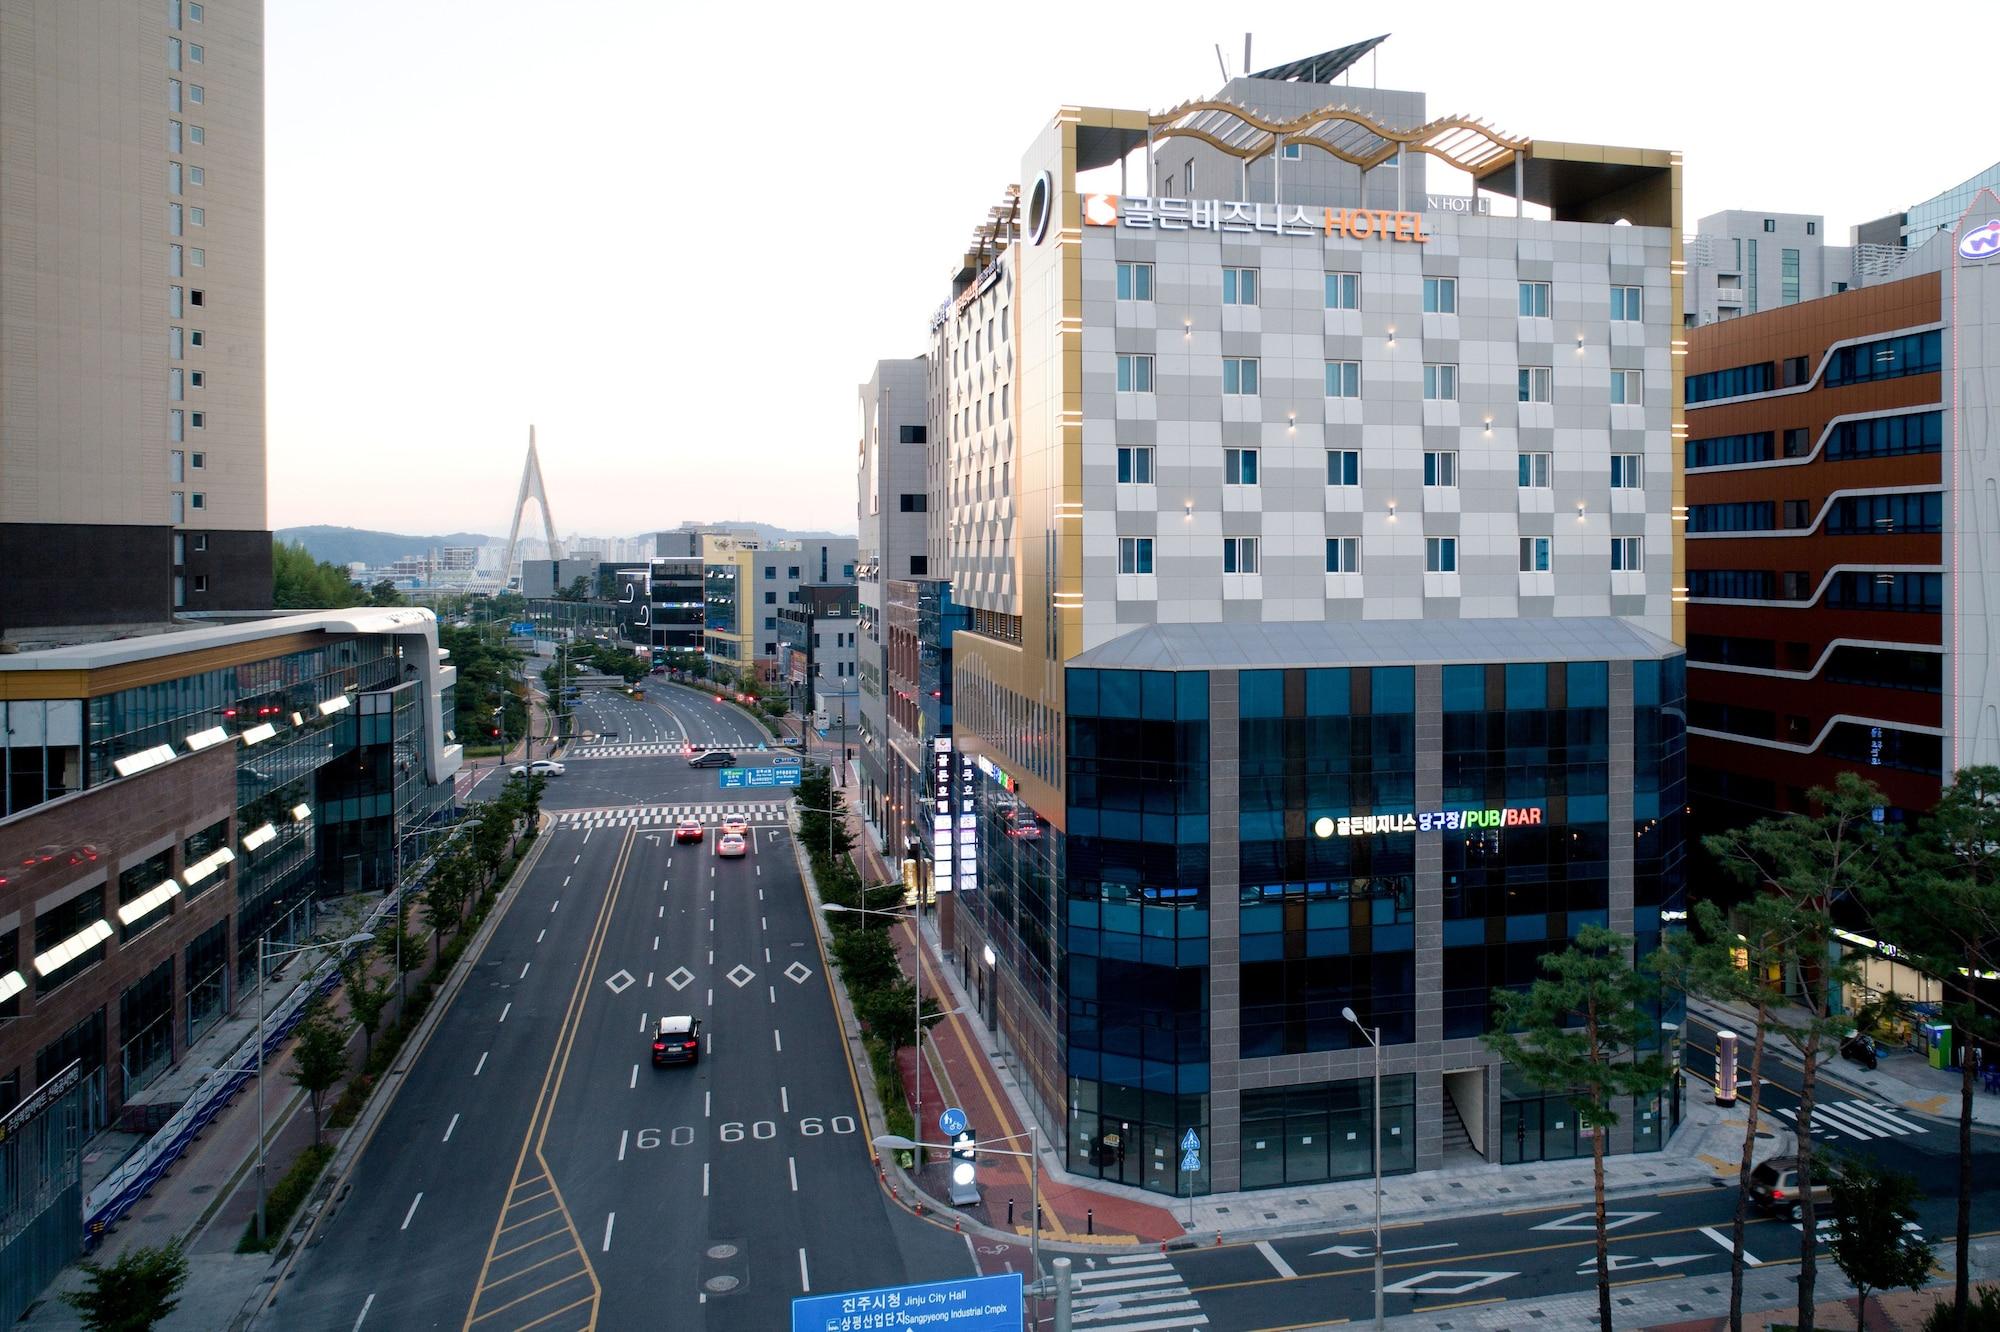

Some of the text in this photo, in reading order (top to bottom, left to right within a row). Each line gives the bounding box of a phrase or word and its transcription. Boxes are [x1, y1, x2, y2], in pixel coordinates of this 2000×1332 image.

[1443, 198, 1485, 213] HOTL
[1124, 195, 1431, 243] 골든비즈니스 HOTEL
[1337, 813, 1416, 836] 골든비지니스
[719, 1120, 777, 1142] 60
[799, 1115, 856, 1136] 60
[636, 1126, 695, 1149] 60
[842, 1290, 967, 1313] 진주시청 Jinju City Hall
[841, 1303, 1007, 1332] 상평산업단지 Sangpyeong Industrial Cmplx
